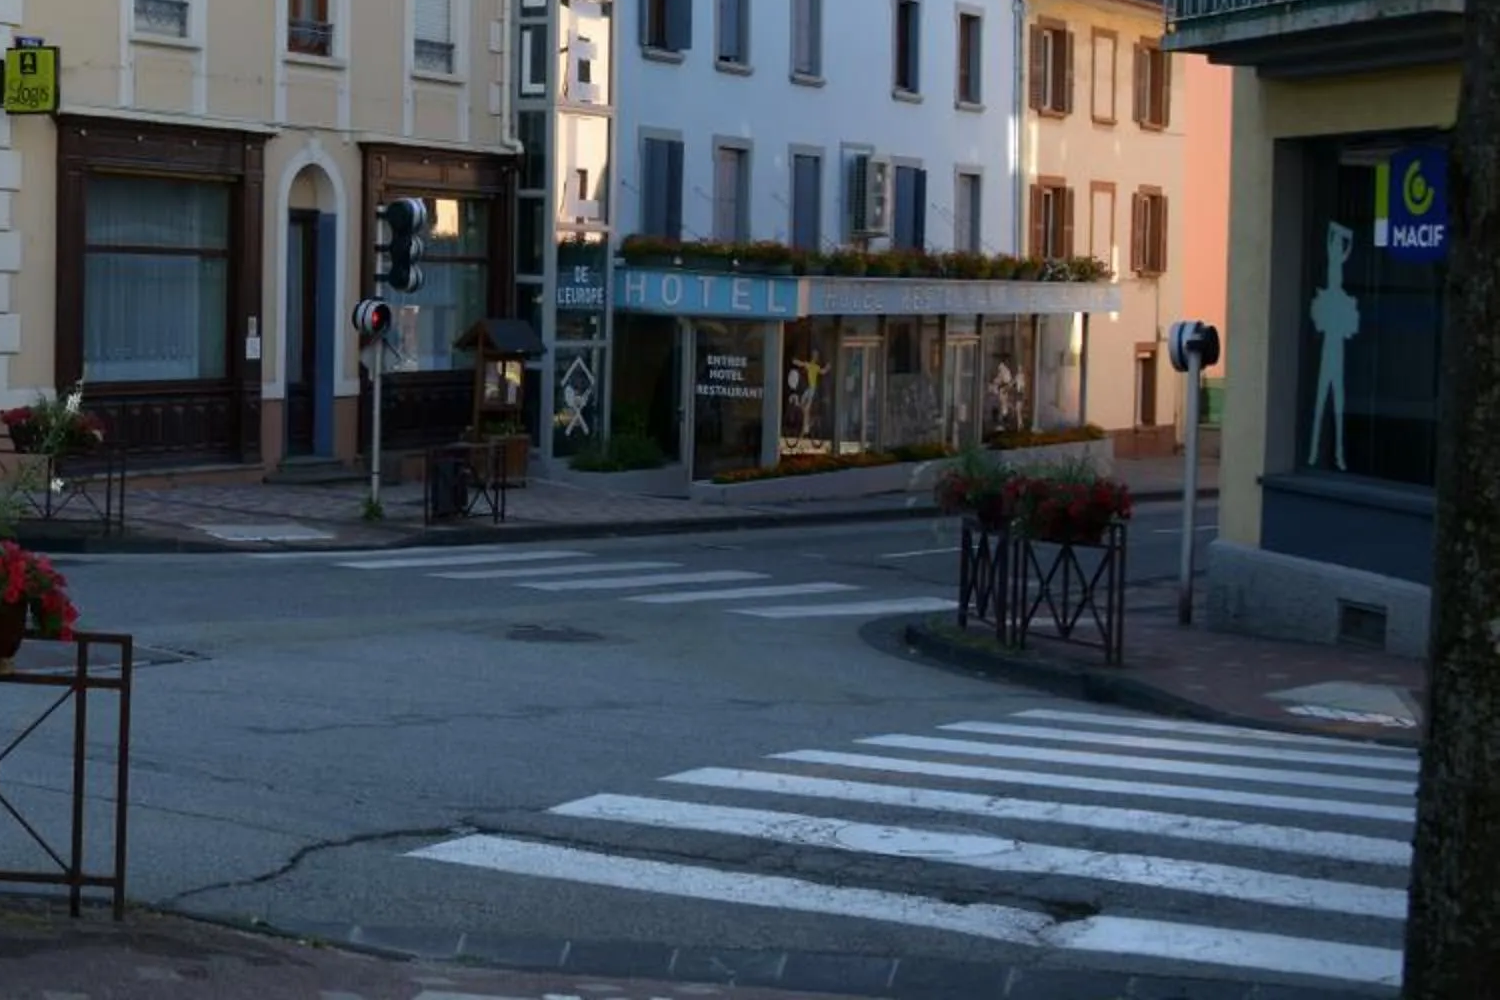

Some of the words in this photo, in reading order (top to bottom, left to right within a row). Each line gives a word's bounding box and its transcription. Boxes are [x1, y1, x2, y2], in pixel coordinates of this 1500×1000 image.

[1392, 224, 1445, 247] MACIF
[623, 271, 788, 313] HOTEL
[709, 369, 745, 381] HOTEL
[696, 384, 764, 399] RESTAURANT
